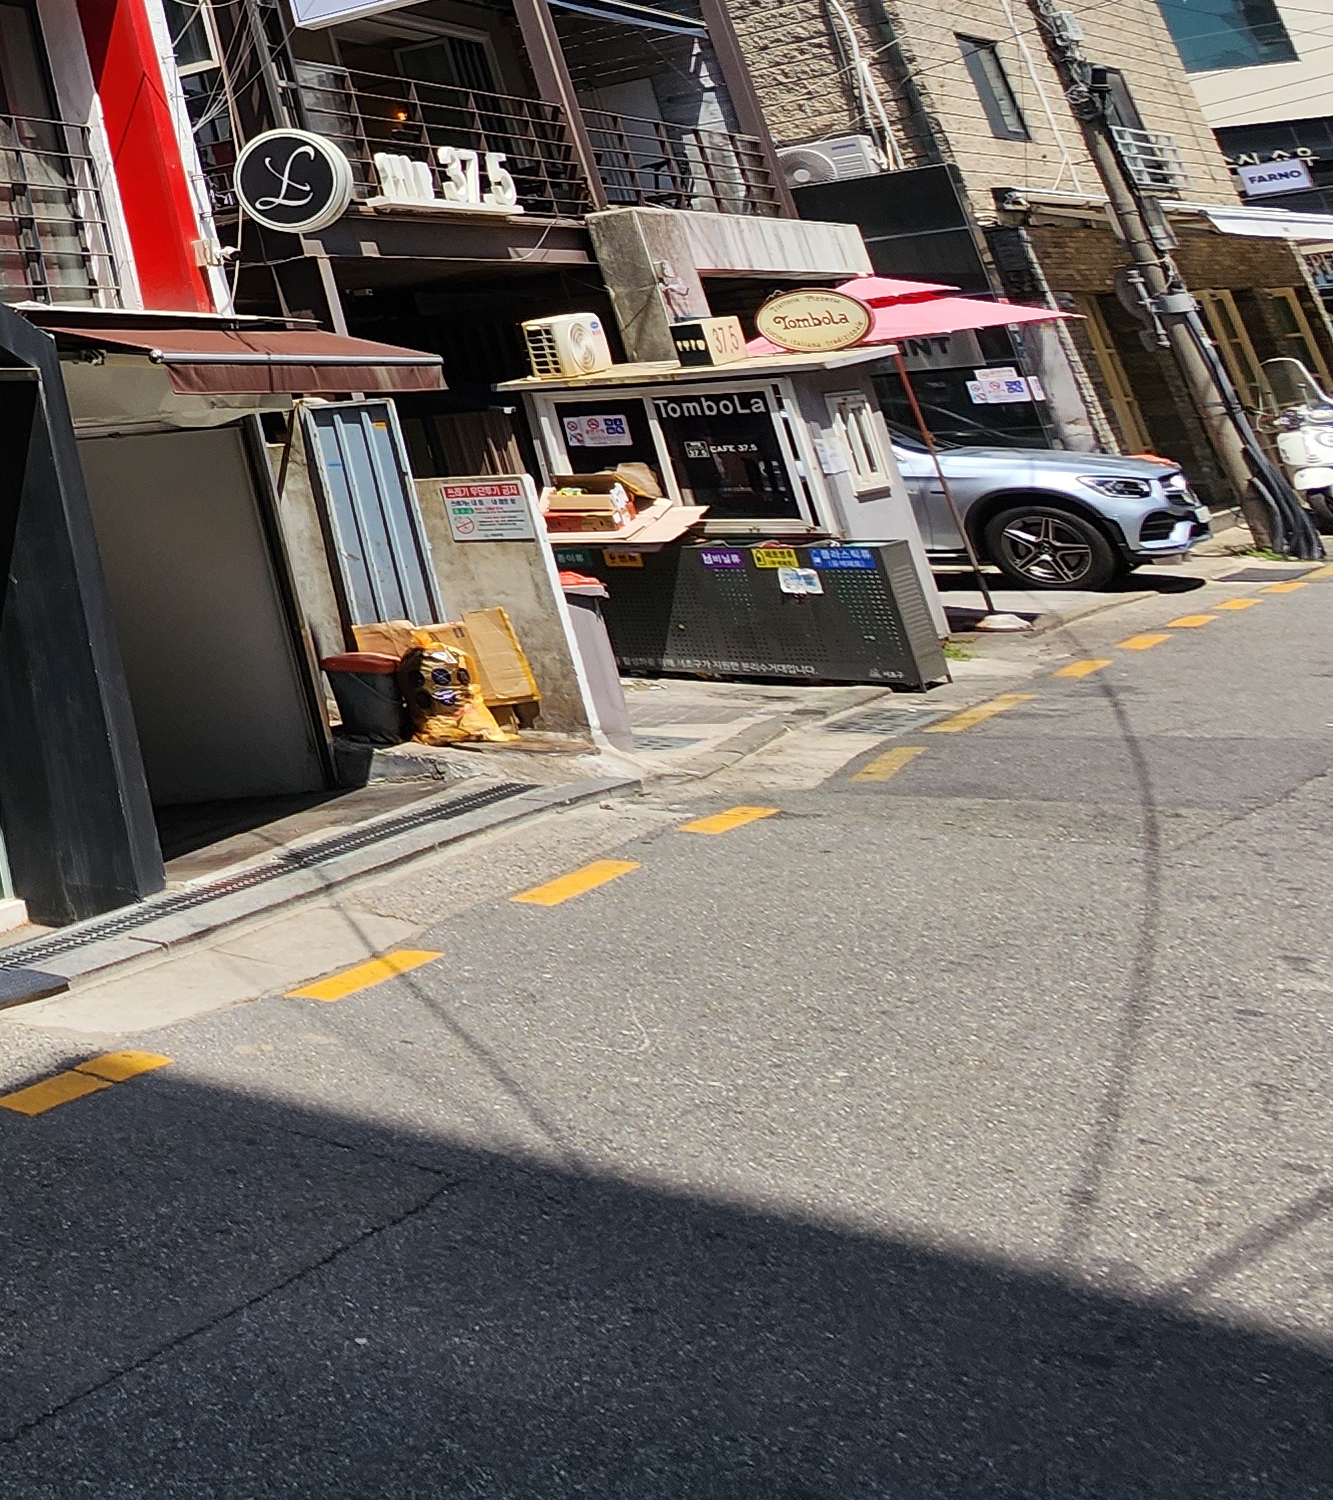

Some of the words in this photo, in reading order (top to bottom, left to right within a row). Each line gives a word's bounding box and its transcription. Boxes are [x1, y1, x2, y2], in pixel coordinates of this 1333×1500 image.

[1248, 170, 1302, 185] FARNO
[709, 445, 734, 454] CAFE
[738, 444, 758, 453] 37.5
[447, 488, 469, 497] 쓰레기
[470, 486, 501, 496] 무단투기
[501, 485, 518, 495] 금지
[677, 660, 711, 669] 서초구가
[713, 660, 739, 671] 지원한
